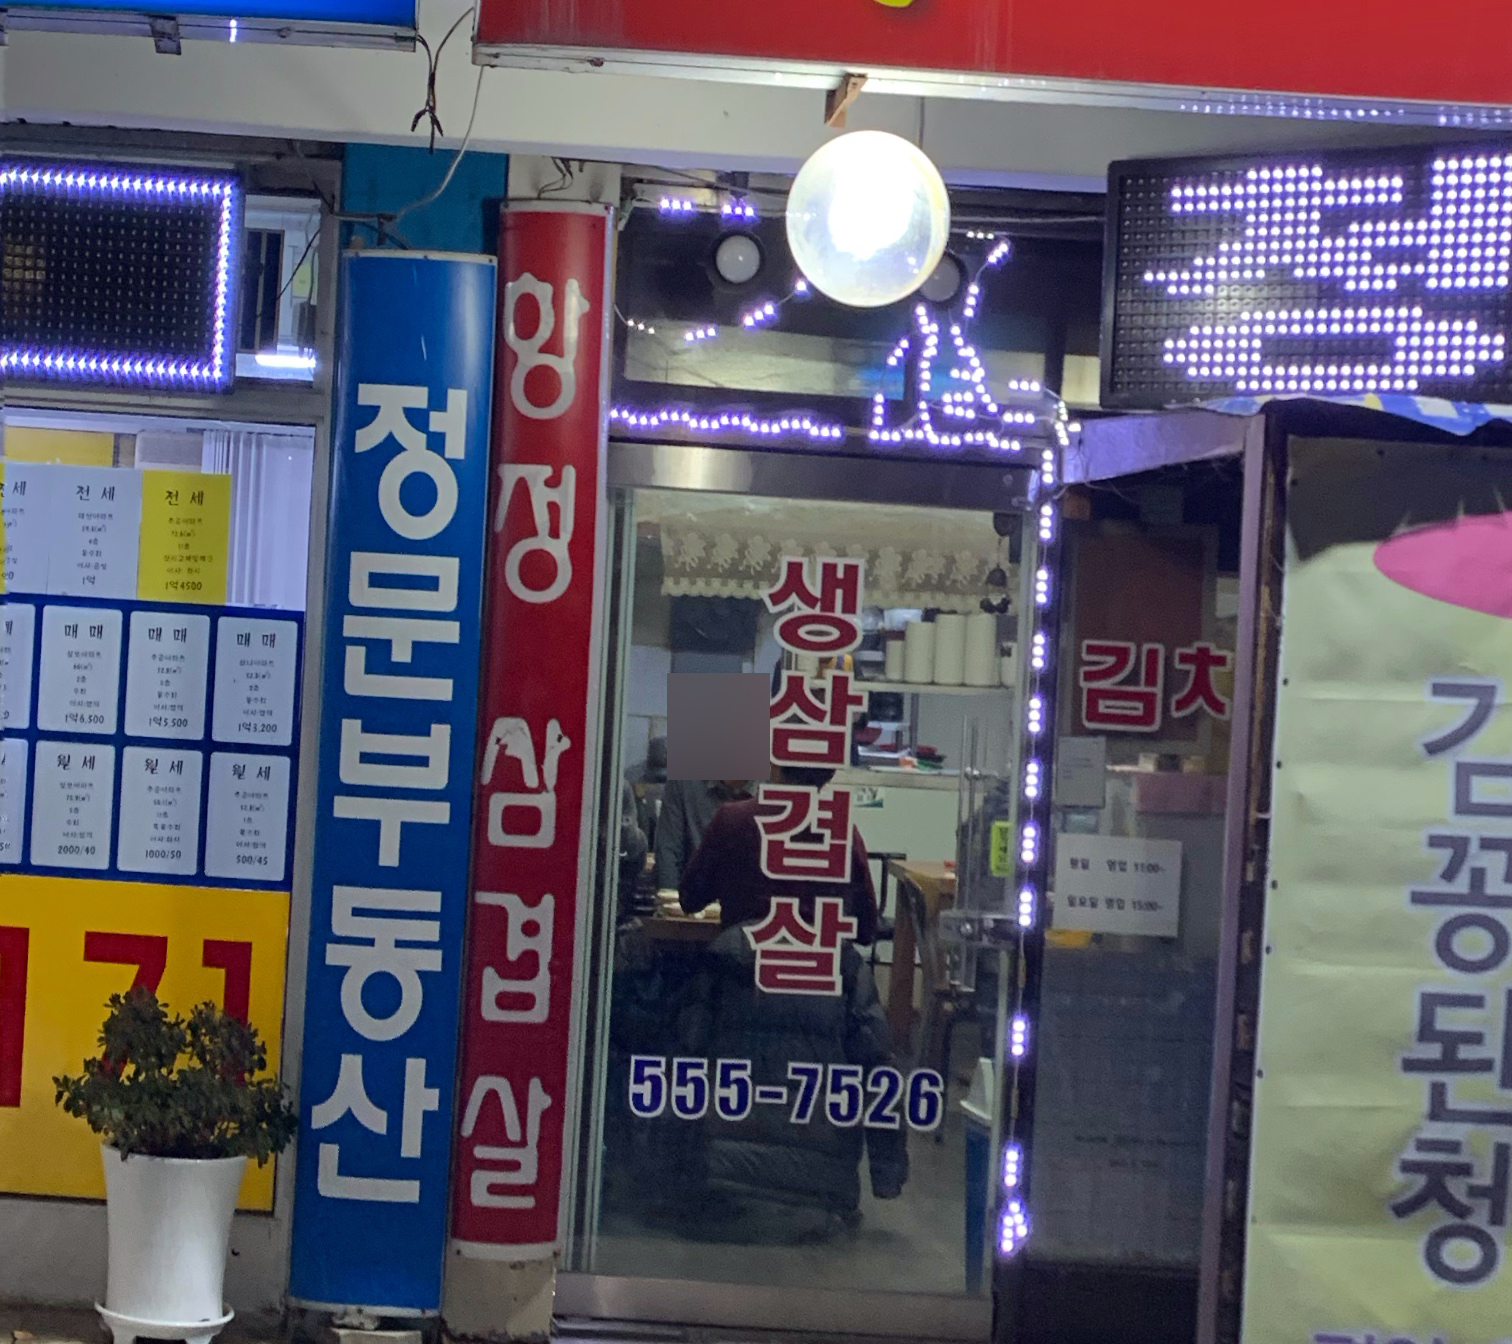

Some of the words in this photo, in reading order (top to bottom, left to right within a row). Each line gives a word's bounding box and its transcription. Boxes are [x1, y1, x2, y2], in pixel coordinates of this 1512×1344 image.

[311, 382, 468, 1203] 정문부동산
[460, 716, 571, 1209] 삼겹살
[742, 556, 868, 995] 생삼겹살
[628, 1053, 944, 1131] 555-7526
